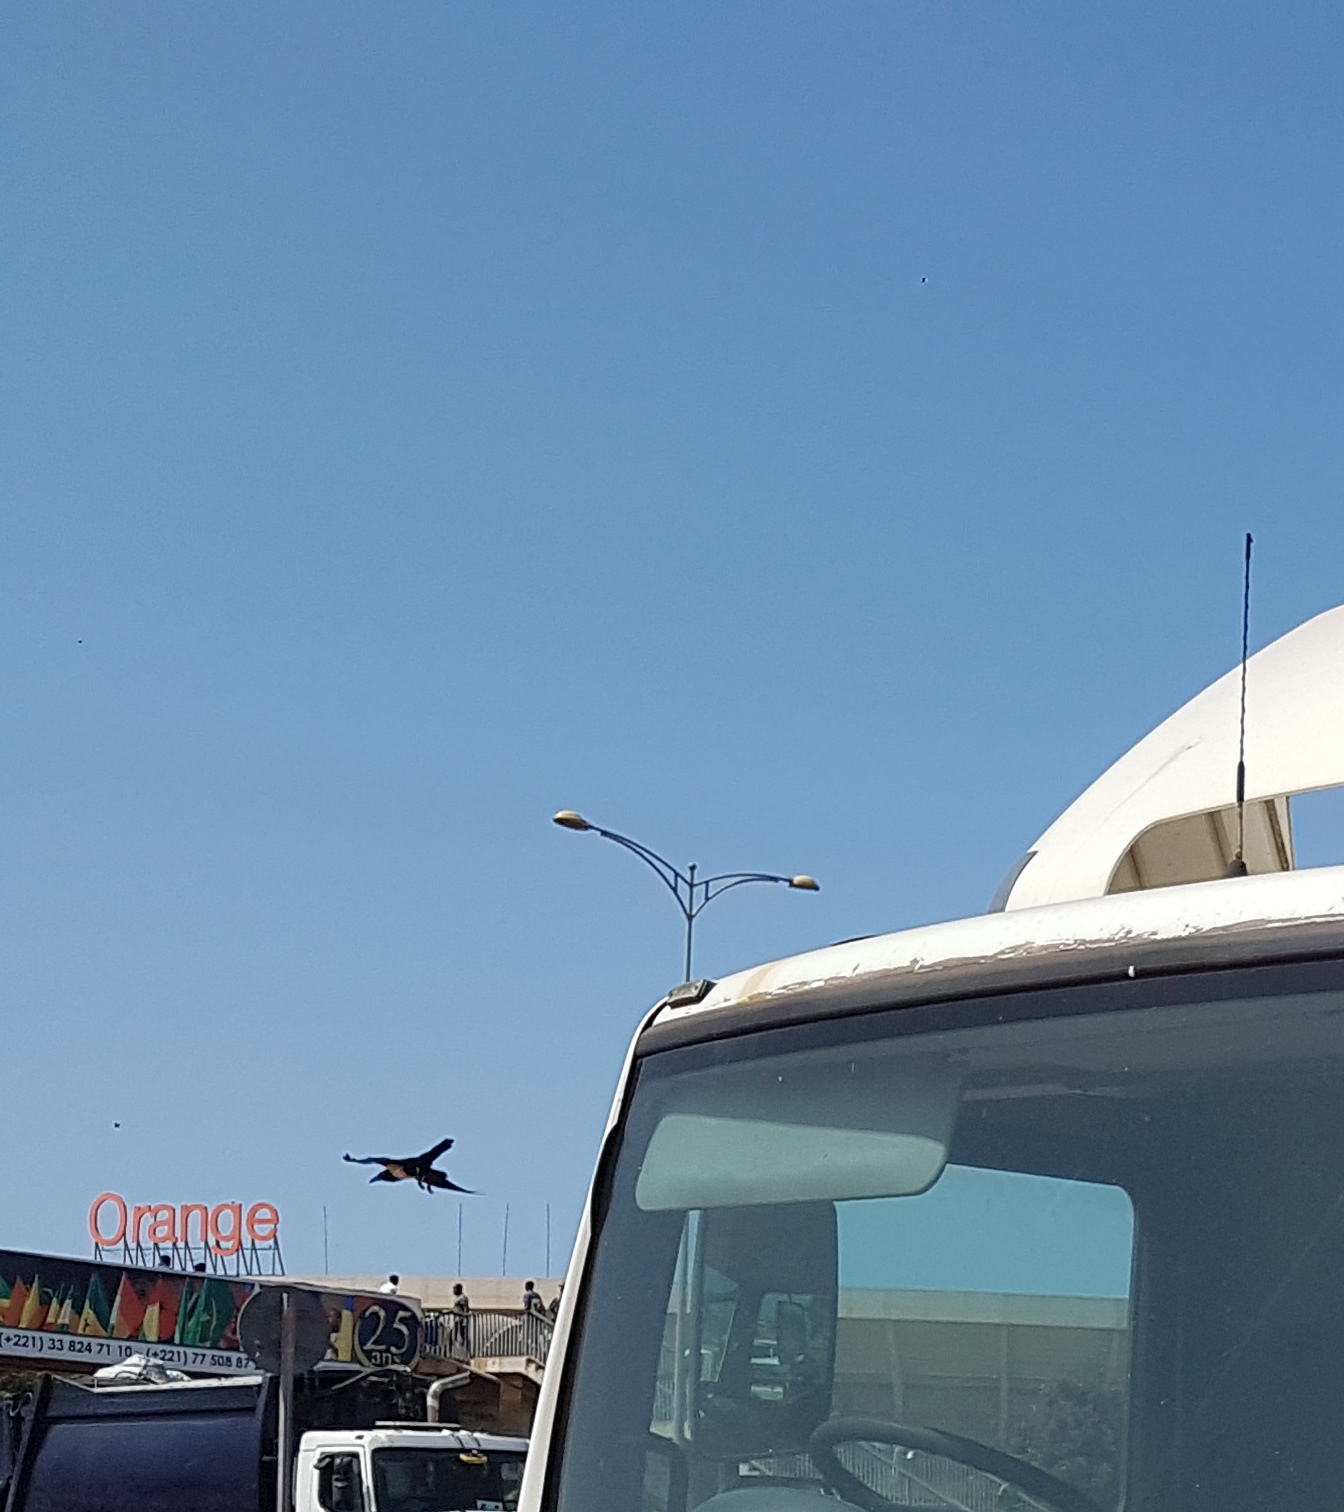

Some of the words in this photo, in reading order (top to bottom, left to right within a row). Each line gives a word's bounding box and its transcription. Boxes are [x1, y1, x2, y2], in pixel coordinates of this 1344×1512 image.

[89, 1192, 280, 1256] Orange
[47, 1338, 64, 1352] 33
[68, 1341, 93, 1355] 824
[97, 1343, 111, 1357] 71
[118, 1345, 133, 1358] 10
[191, 1353, 207, 1367] 77
[211, 1355, 233, 1369] 508
[363, 1304, 413, 1354] 25
